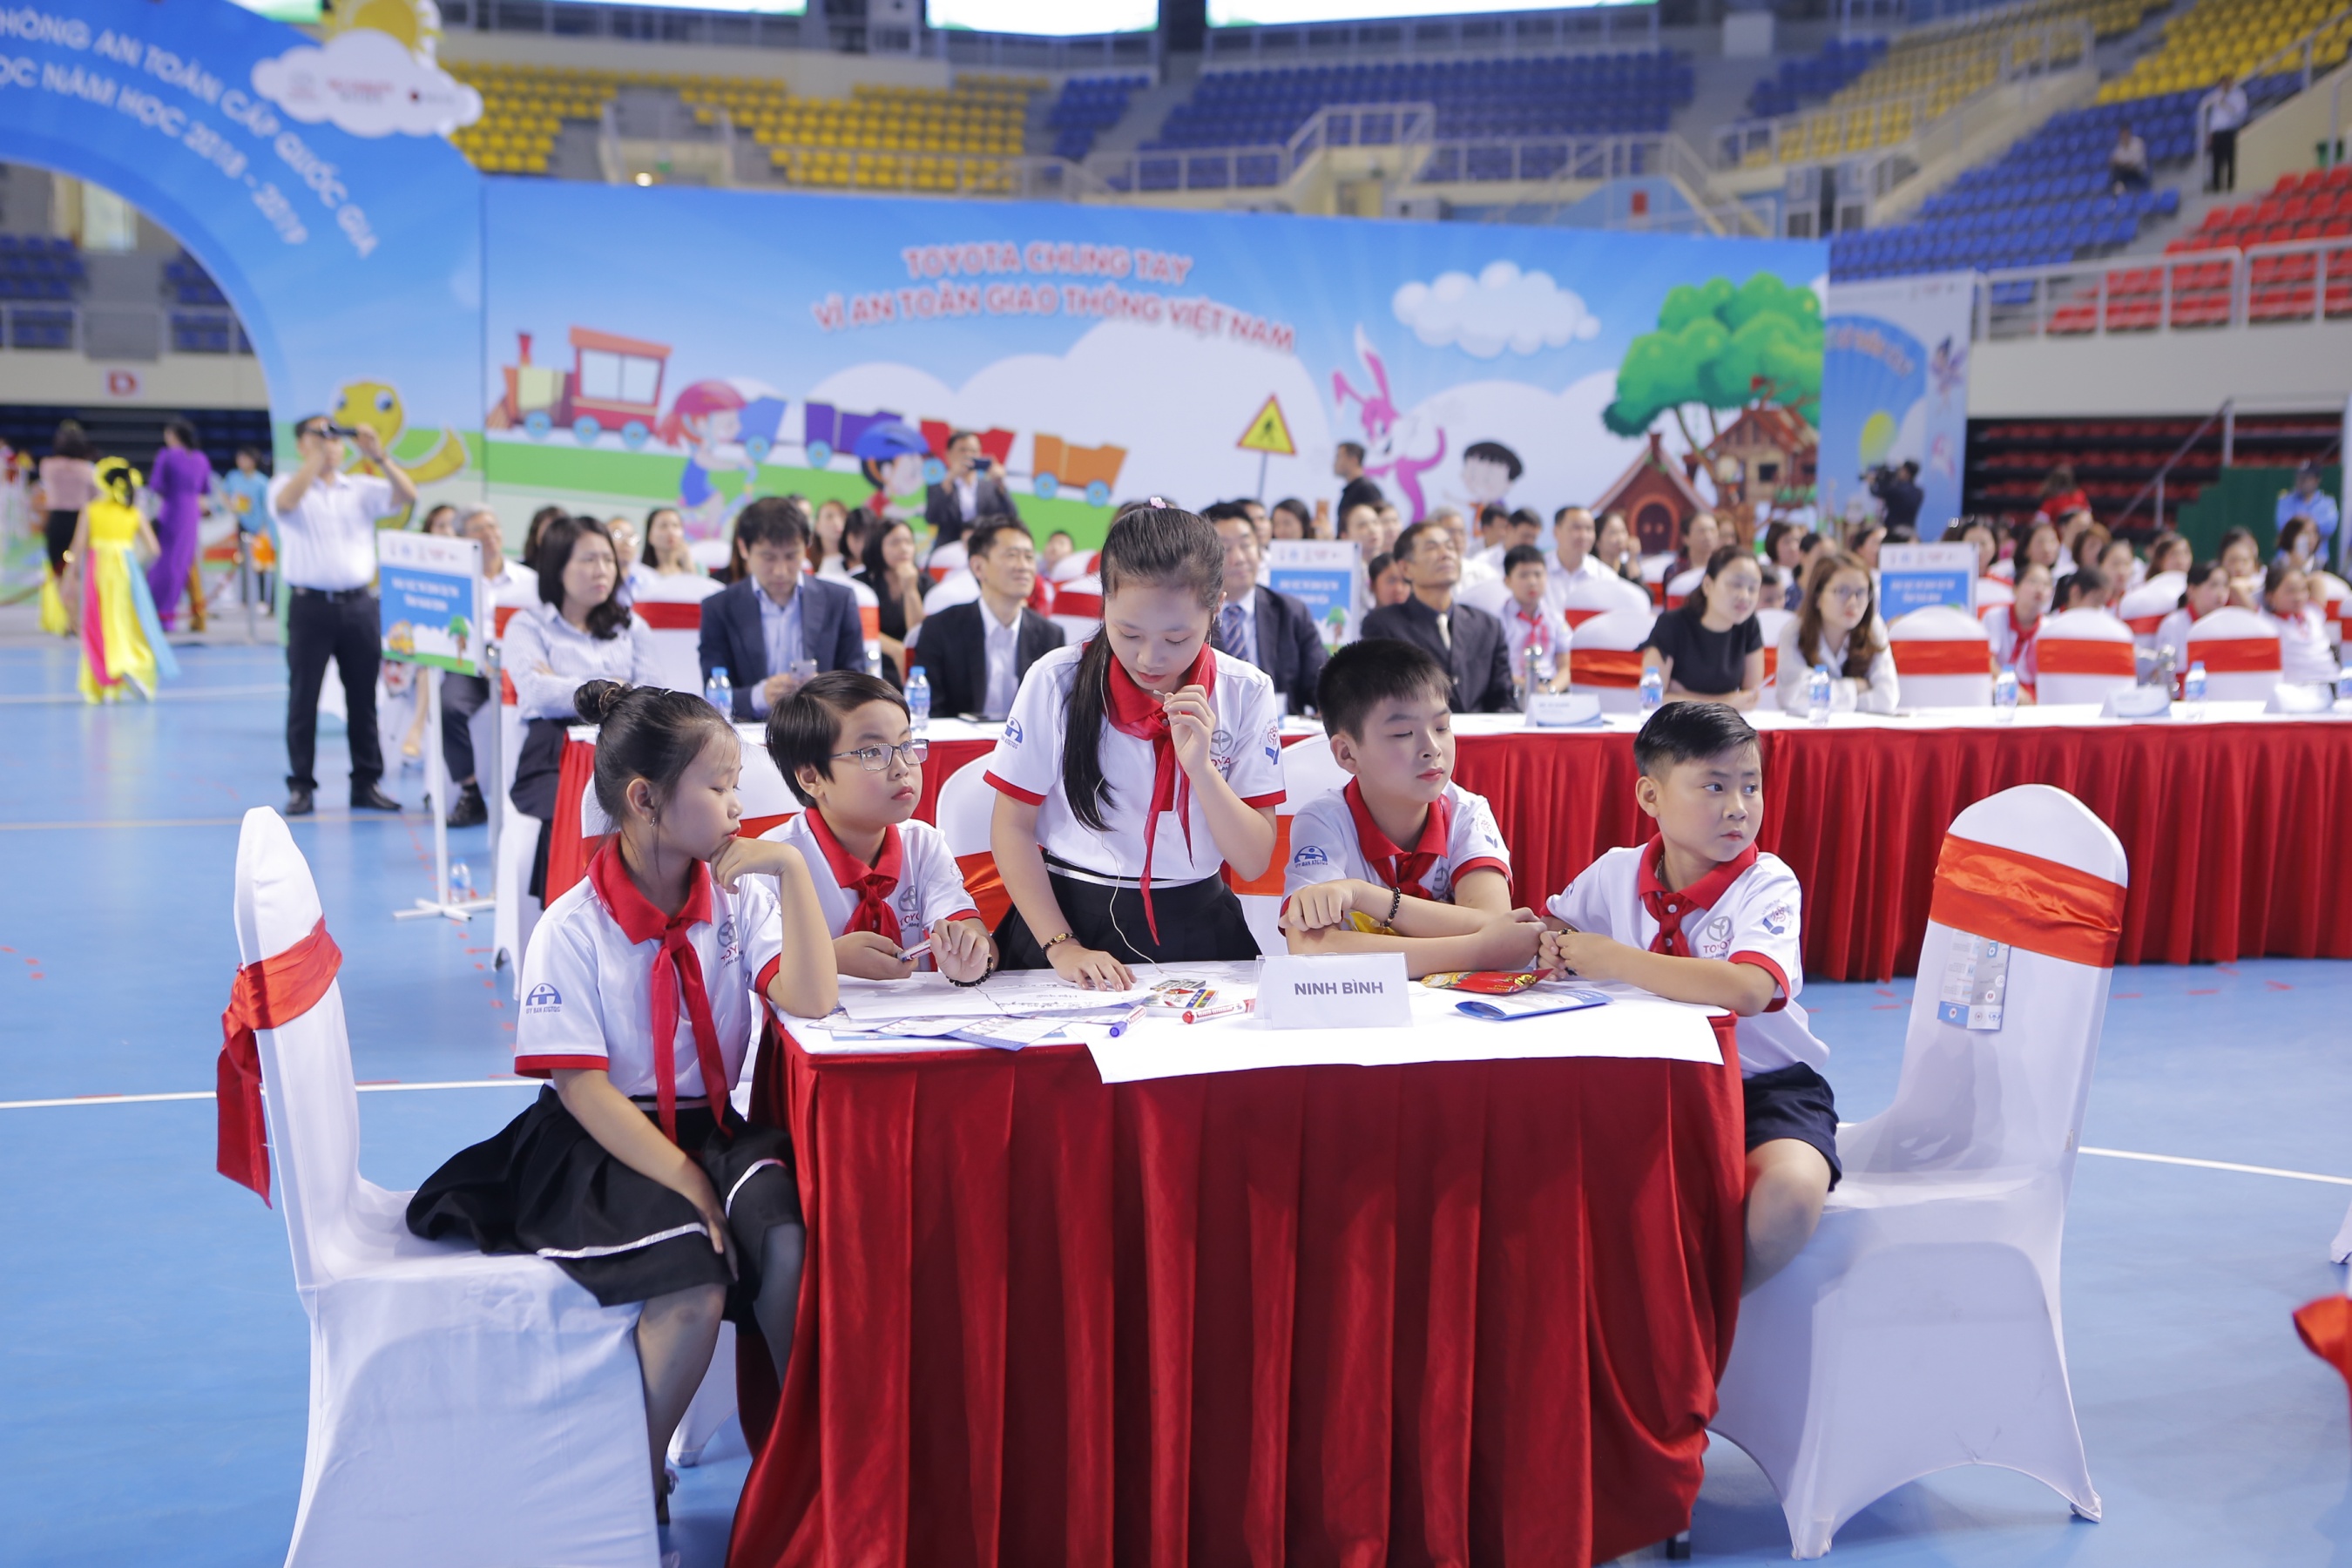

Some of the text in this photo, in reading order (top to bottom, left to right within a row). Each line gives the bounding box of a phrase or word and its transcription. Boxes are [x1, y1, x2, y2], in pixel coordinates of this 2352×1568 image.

[94, 30, 142, 67] AN
[904, 241, 1193, 285] TOYOTA CHUNG TAY
[851, 292, 895, 326] AN
[898, 280, 980, 319] TOÀN
[986, 283, 1058, 315] GIAO
[1063, 283, 1161, 323] THÔNG
[1168, 297, 1223, 337] VIỆT
[1228, 311, 1294, 351] NAM
[110, 369, 137, 397] D
[1294, 979, 1383, 995] NINH BÌNH
